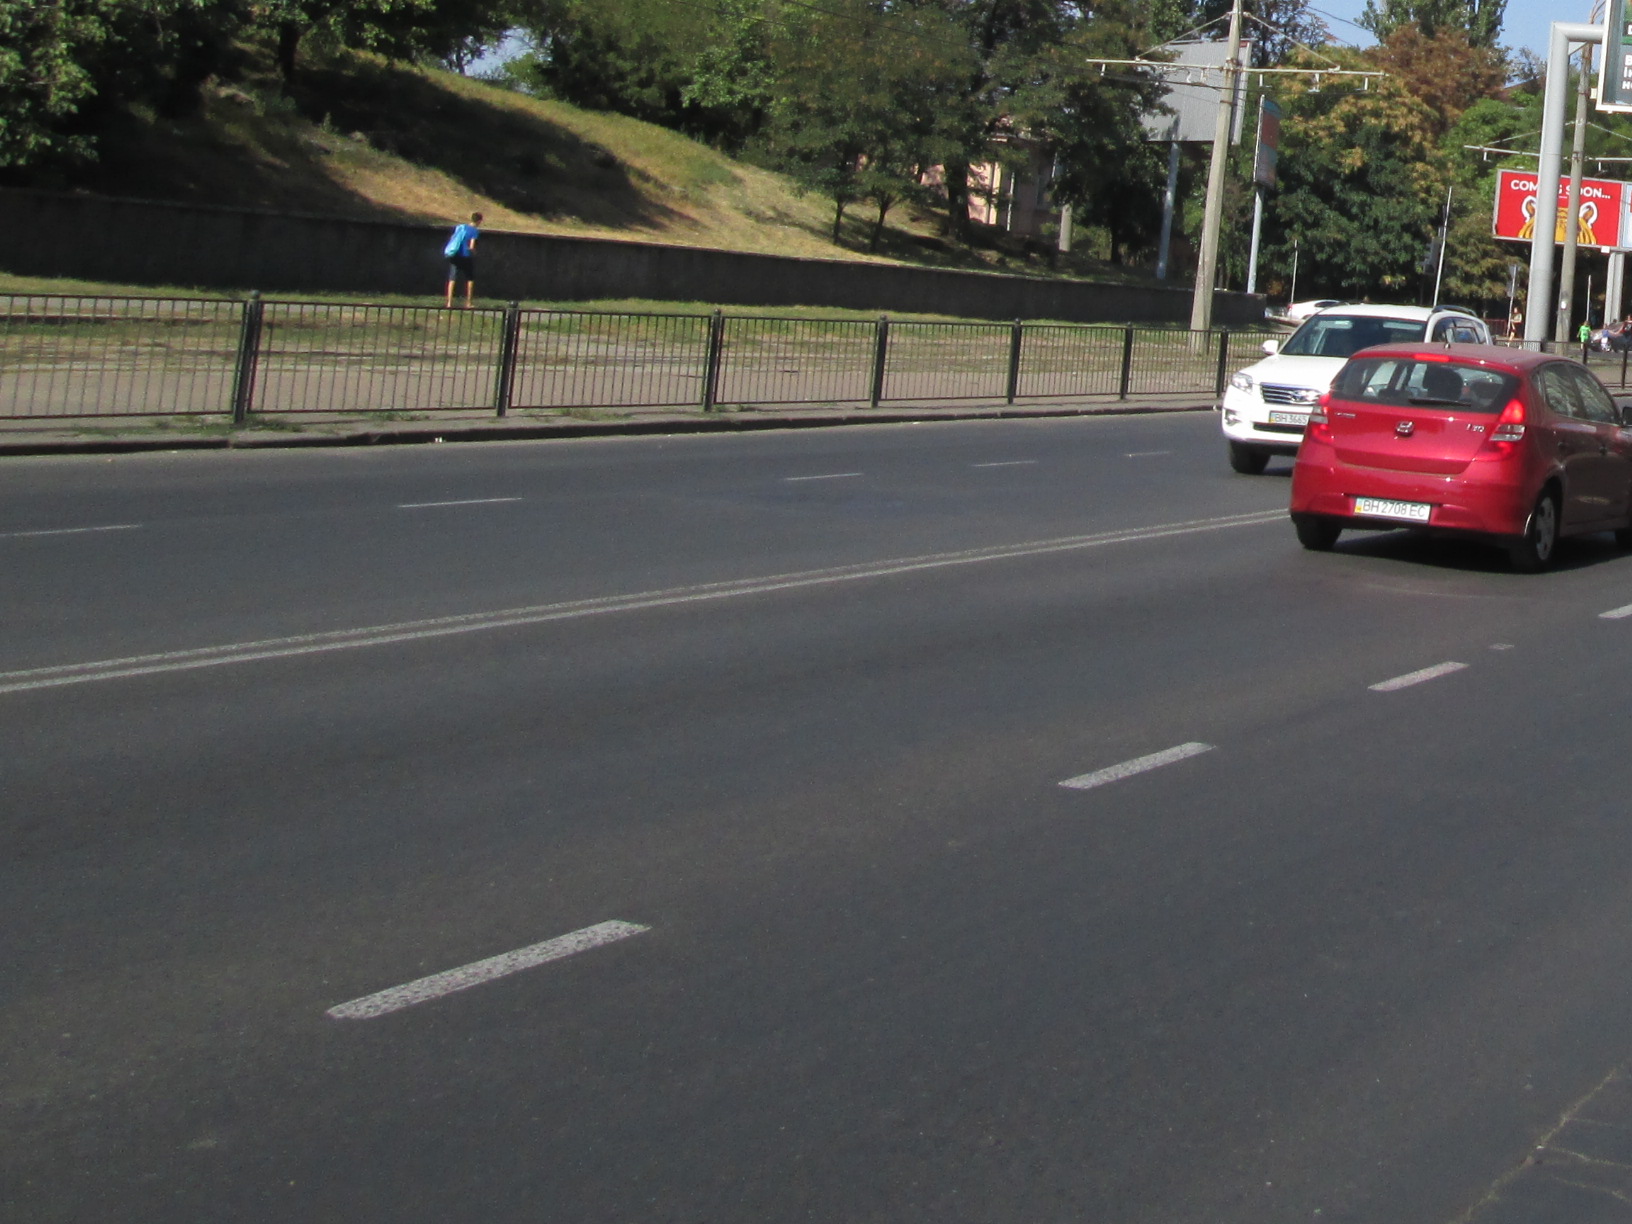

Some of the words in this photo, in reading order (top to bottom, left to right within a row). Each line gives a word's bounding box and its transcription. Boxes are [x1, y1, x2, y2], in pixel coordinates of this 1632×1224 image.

[1565, 183, 1611, 200] SON...
[1363, 499, 1380, 513] BH
[1381, 501, 1408, 515] 2708
[1409, 504, 1427, 518] EC
